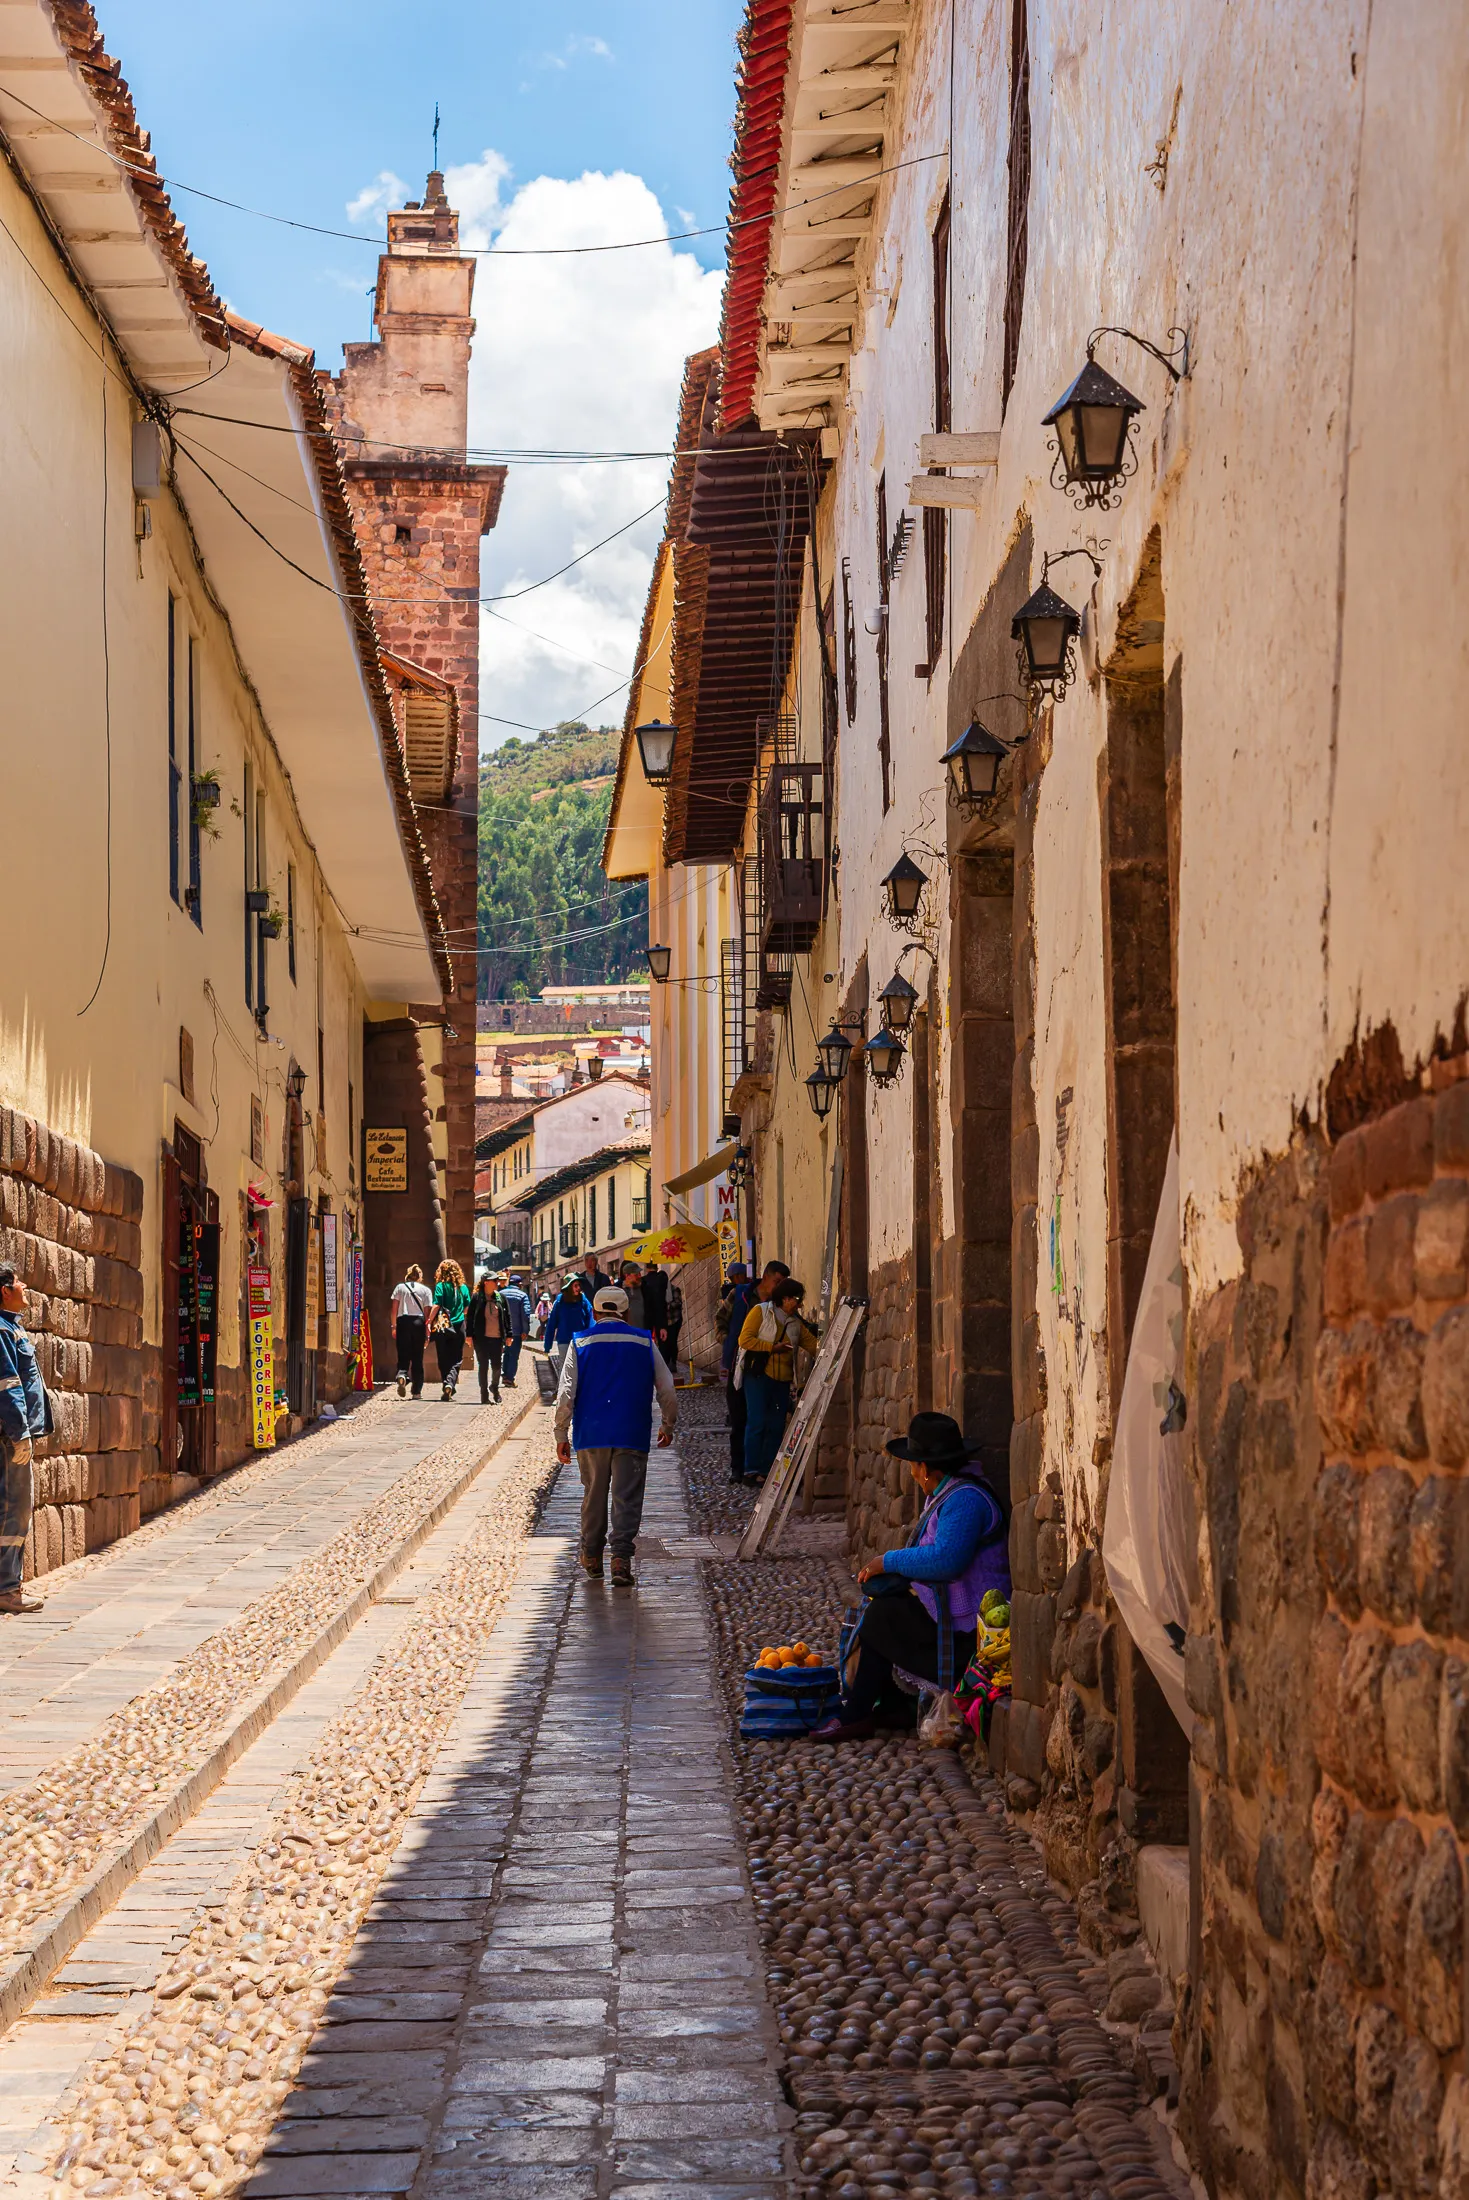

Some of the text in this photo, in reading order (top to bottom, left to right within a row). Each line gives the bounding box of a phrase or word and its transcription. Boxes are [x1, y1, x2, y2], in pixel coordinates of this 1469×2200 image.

[367, 1153, 405, 1165] Imperial
[254, 1321, 265, 1444] FOTOCOPIAS
[360, 1312, 368, 1391] FOTOCOPIAS
